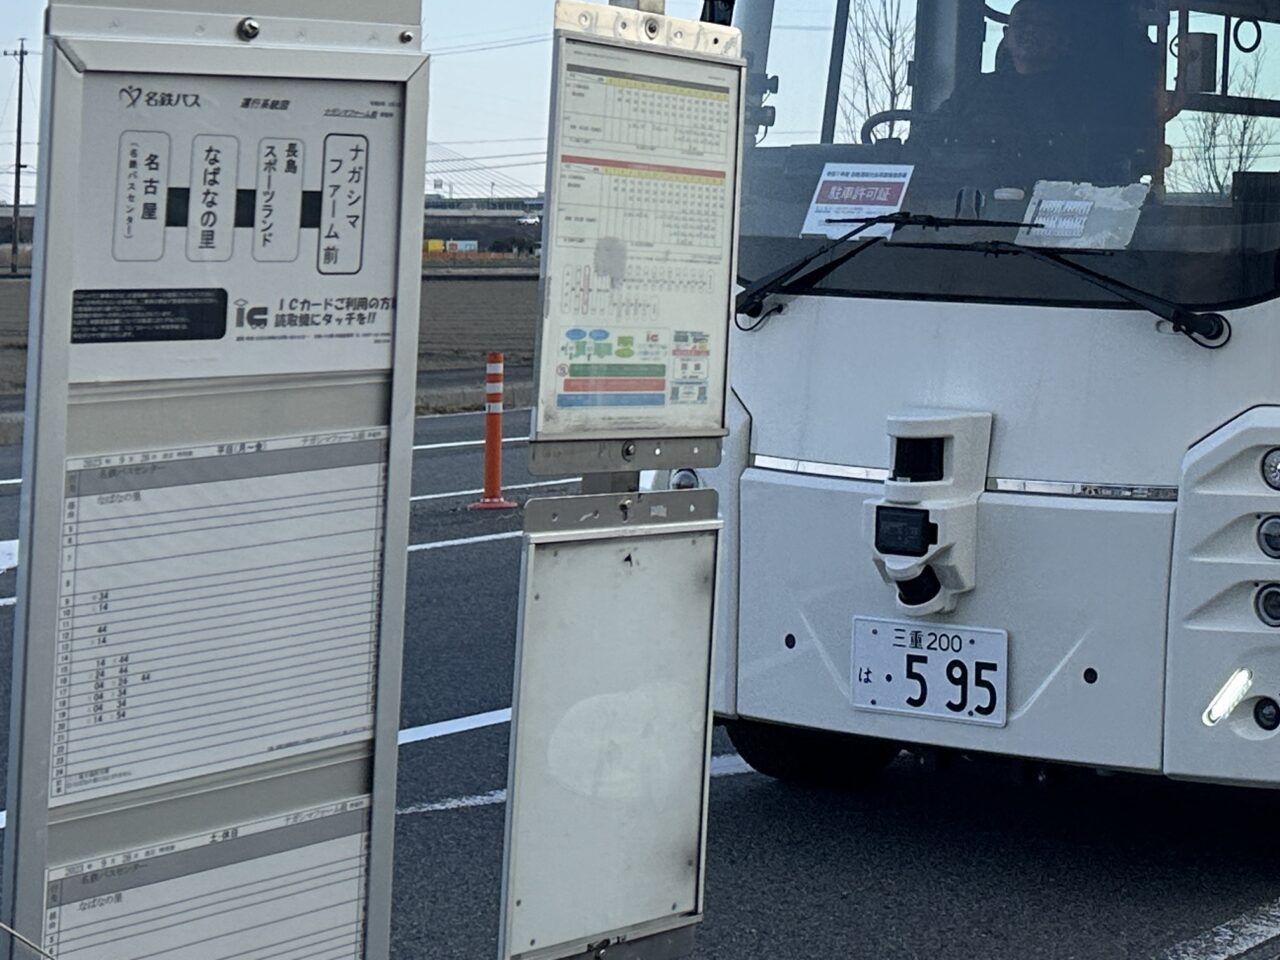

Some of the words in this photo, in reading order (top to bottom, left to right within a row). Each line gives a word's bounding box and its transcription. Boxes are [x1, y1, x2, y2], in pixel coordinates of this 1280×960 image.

[144, 91, 201, 108] 名鉄バス
[284, 143, 298, 174] 長島
[141, 153, 159, 220] 名古屋
[198, 145, 221, 249] なばなの里
[260, 145, 277, 248] スポーツランド
[346, 144, 364, 229] ナガシマ
[323, 158, 342, 265] ファーム前
[94, 681, 104, 690] 04
[141, 673, 150, 681] 44
[858, 667, 872, 684] は
[93, 692, 103, 701] 04
[93, 703, 103, 713] 04
